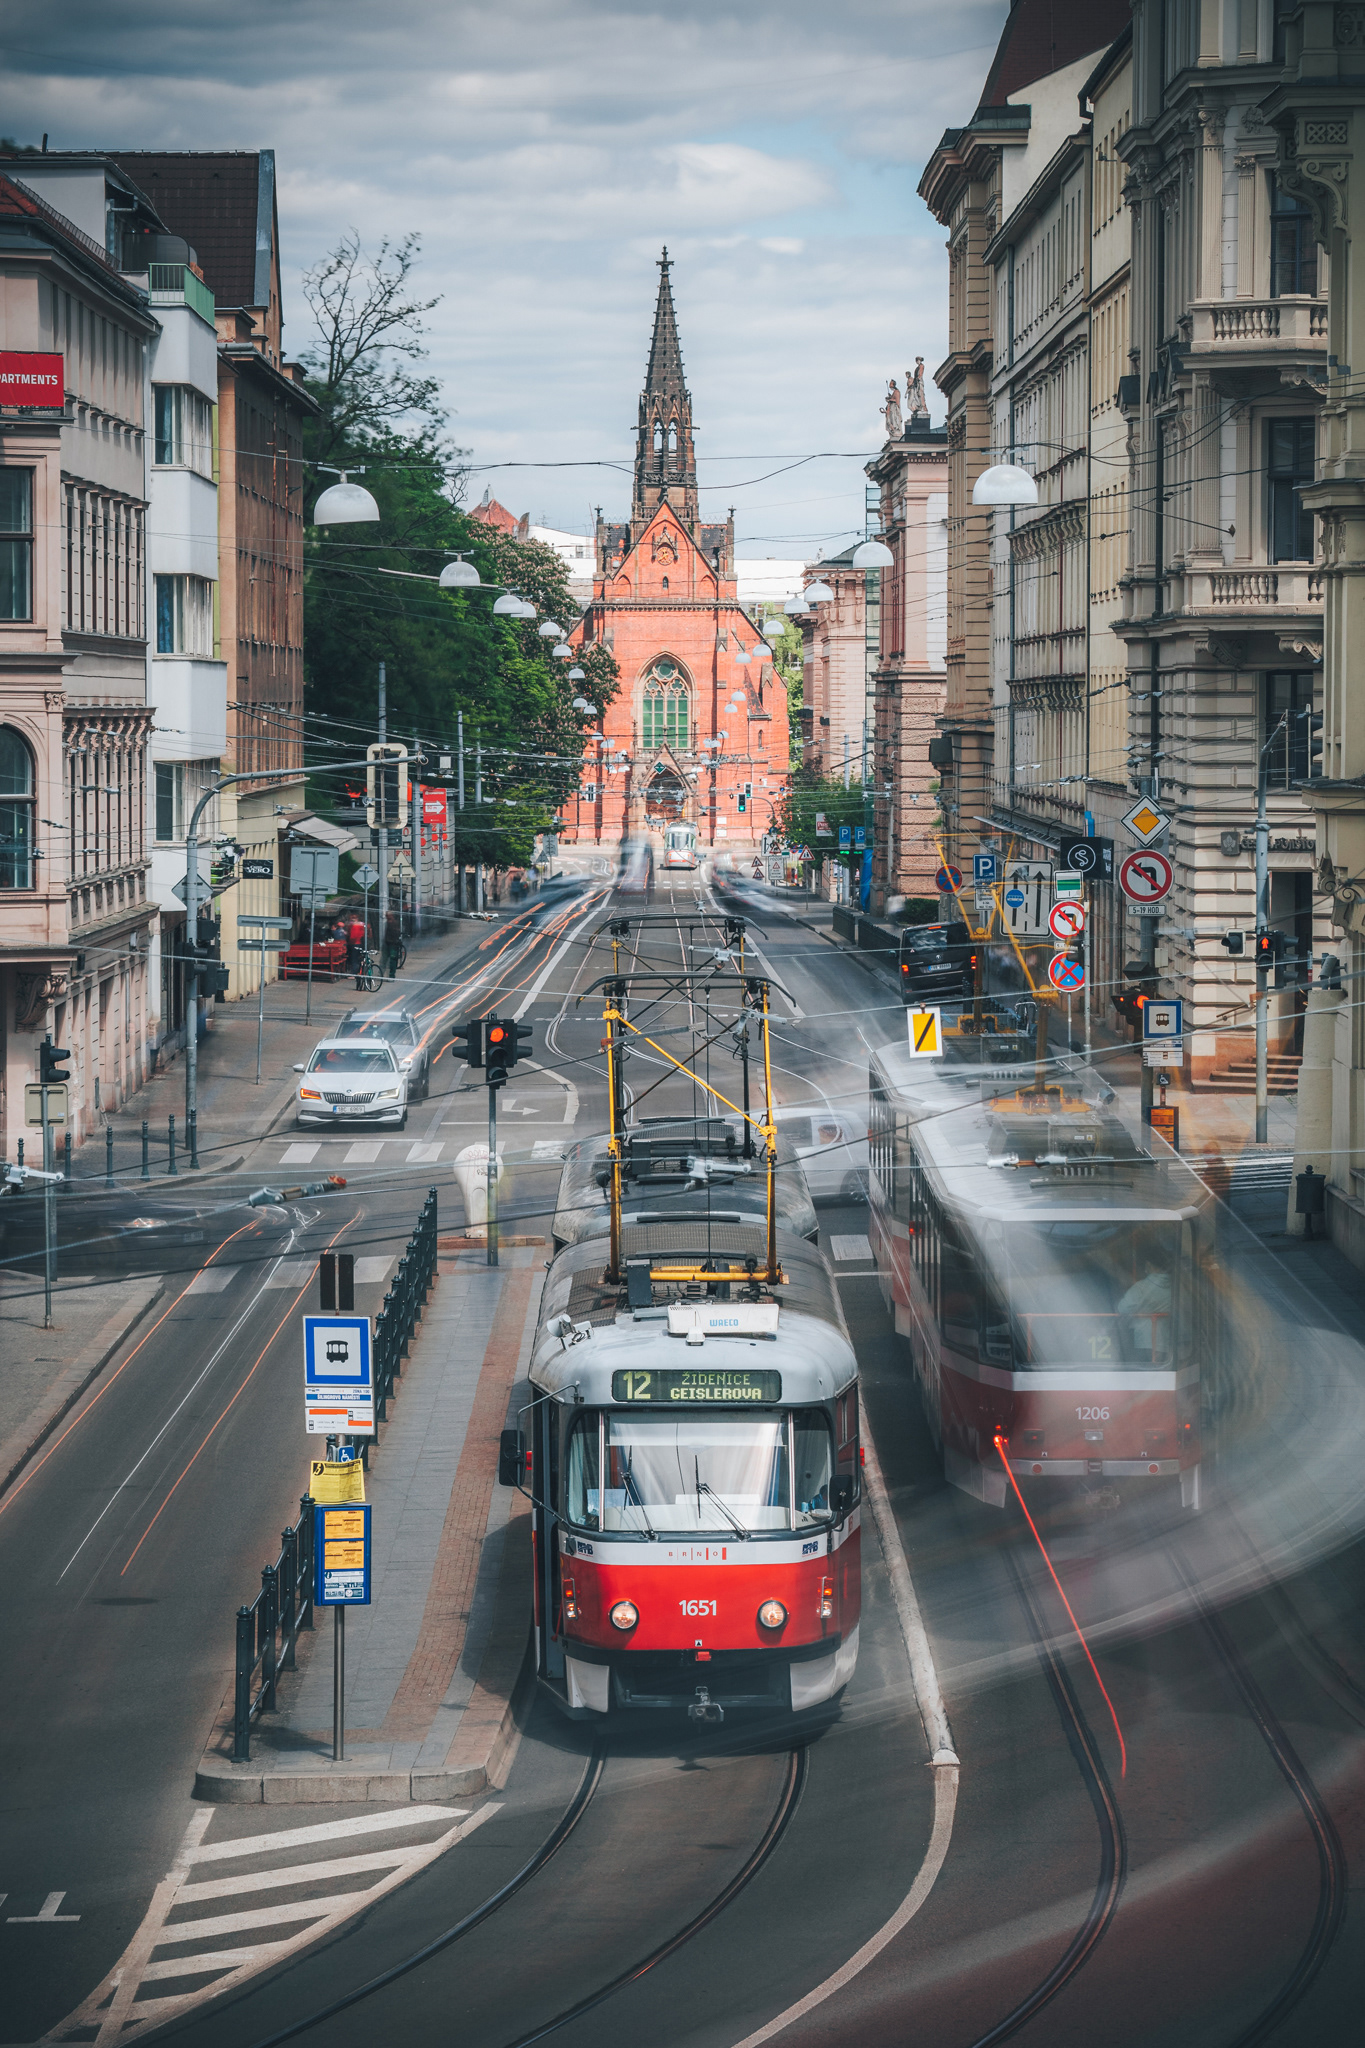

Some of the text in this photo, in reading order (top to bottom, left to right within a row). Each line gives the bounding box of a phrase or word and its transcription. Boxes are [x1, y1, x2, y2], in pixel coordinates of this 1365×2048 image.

[0, 373, 58, 385] ARTMENTS
[1274, 836, 1316, 850] POJIŠŤO
[979, 858, 993, 877] P
[709, 1318, 739, 1327] WAECO
[623, 1370, 750, 1399] 12 ŽIDENICE
[670, 1387, 761, 1400] GEISLEROVA
[1075, 1406, 1110, 1420] 1206
[679, 1600, 717, 1616] 1651
